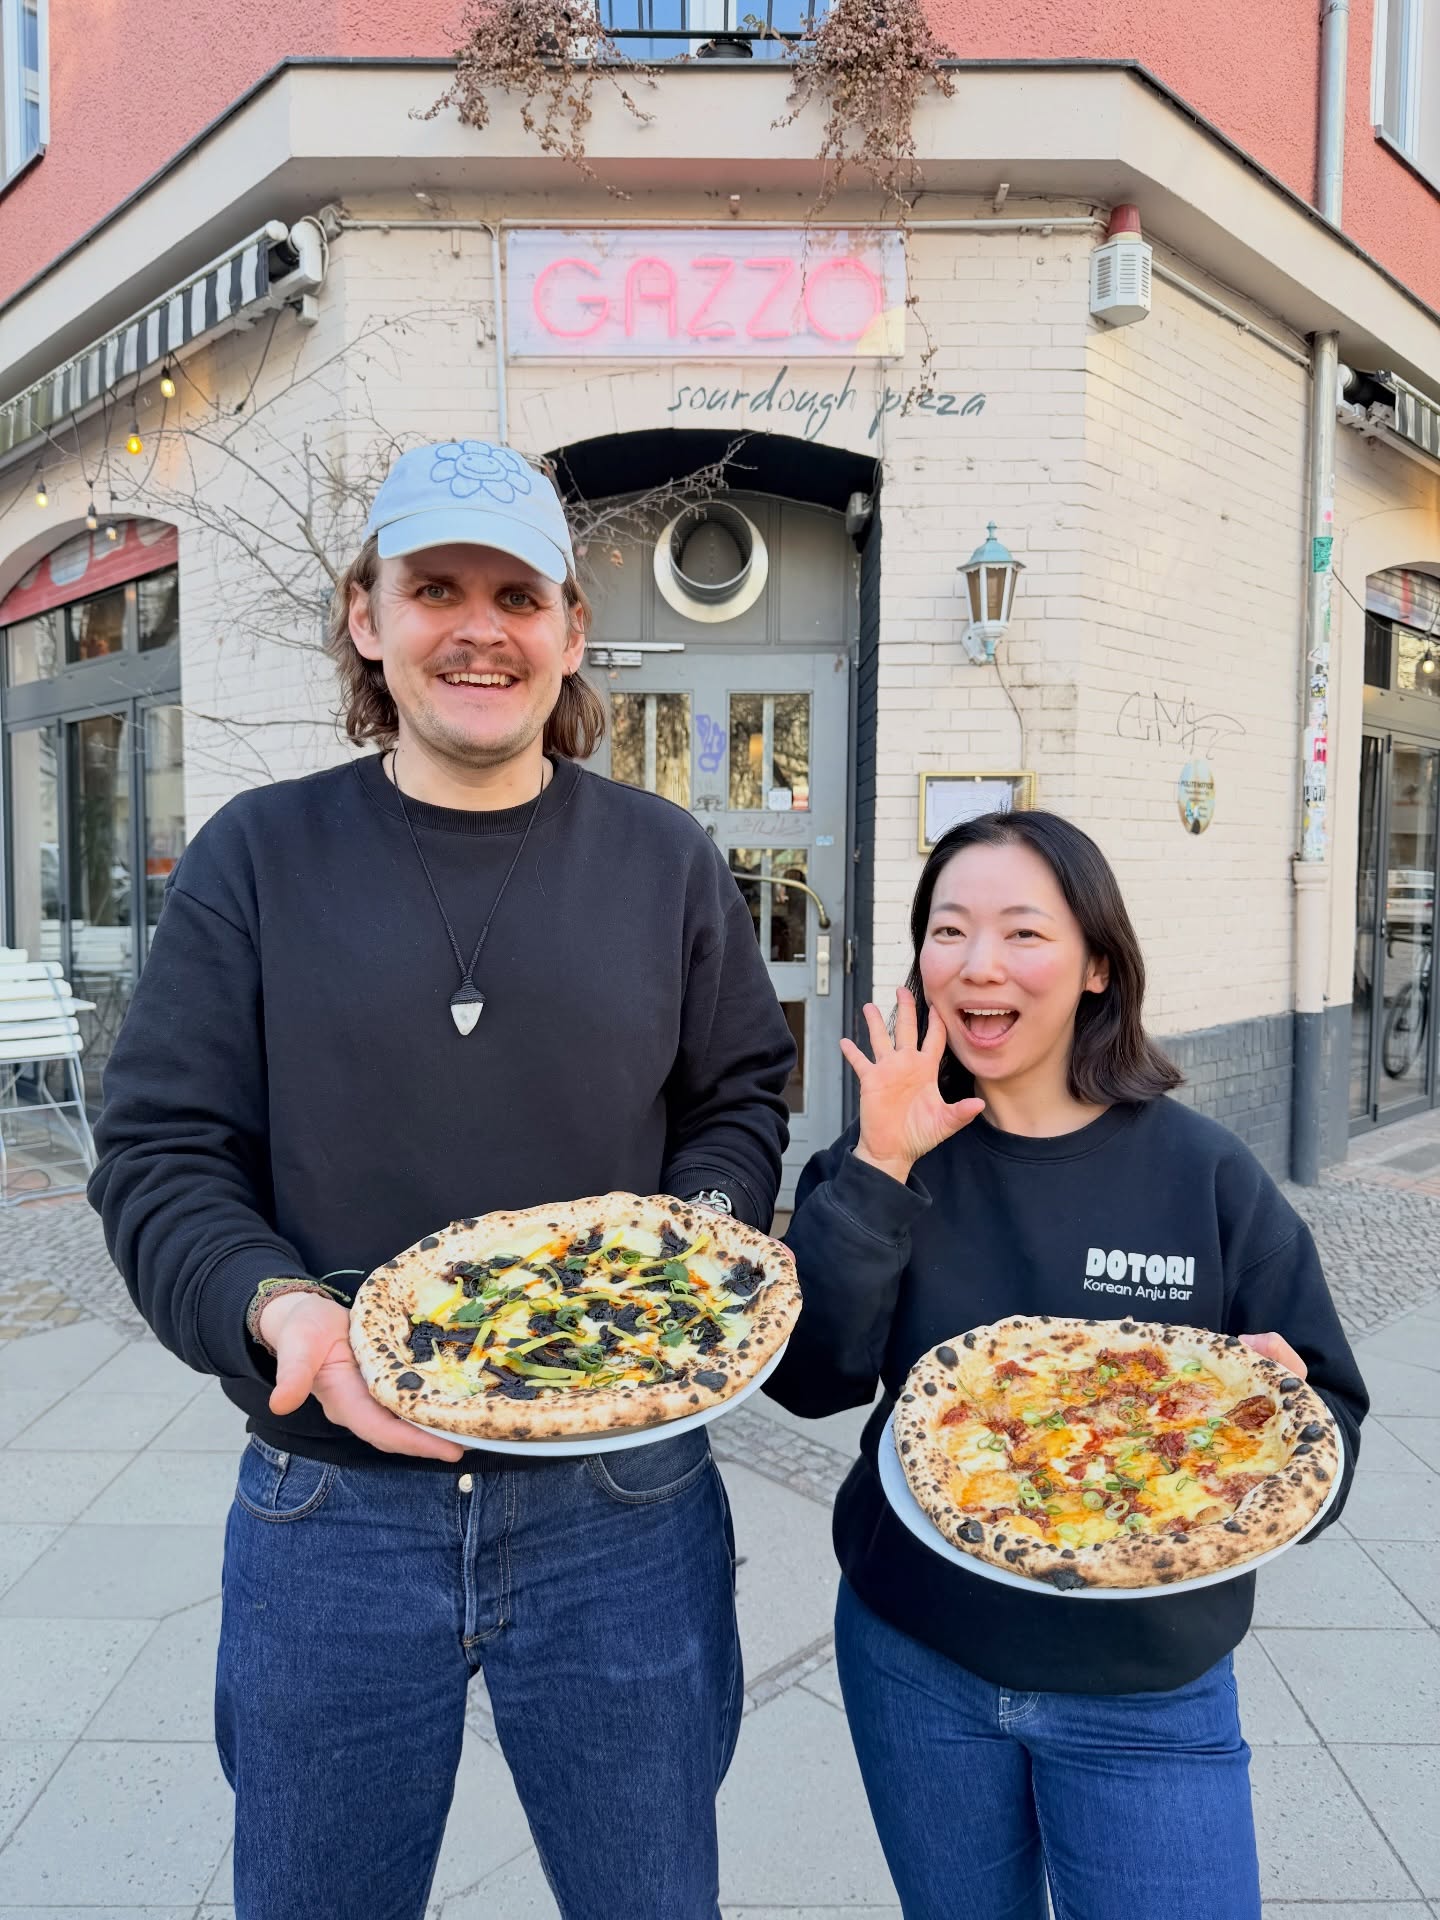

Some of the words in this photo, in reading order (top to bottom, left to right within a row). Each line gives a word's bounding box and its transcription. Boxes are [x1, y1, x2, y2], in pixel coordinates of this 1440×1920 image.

[533, 256, 884, 342] GAZZO
[667, 365, 857, 440] sourdough
[1083, 1278, 1132, 1296] Korean
[1135, 1285, 1166, 1301] Anju
[1169, 1287, 1193, 1301] Bar
[1085, 1247, 1195, 1286] DOTORI
